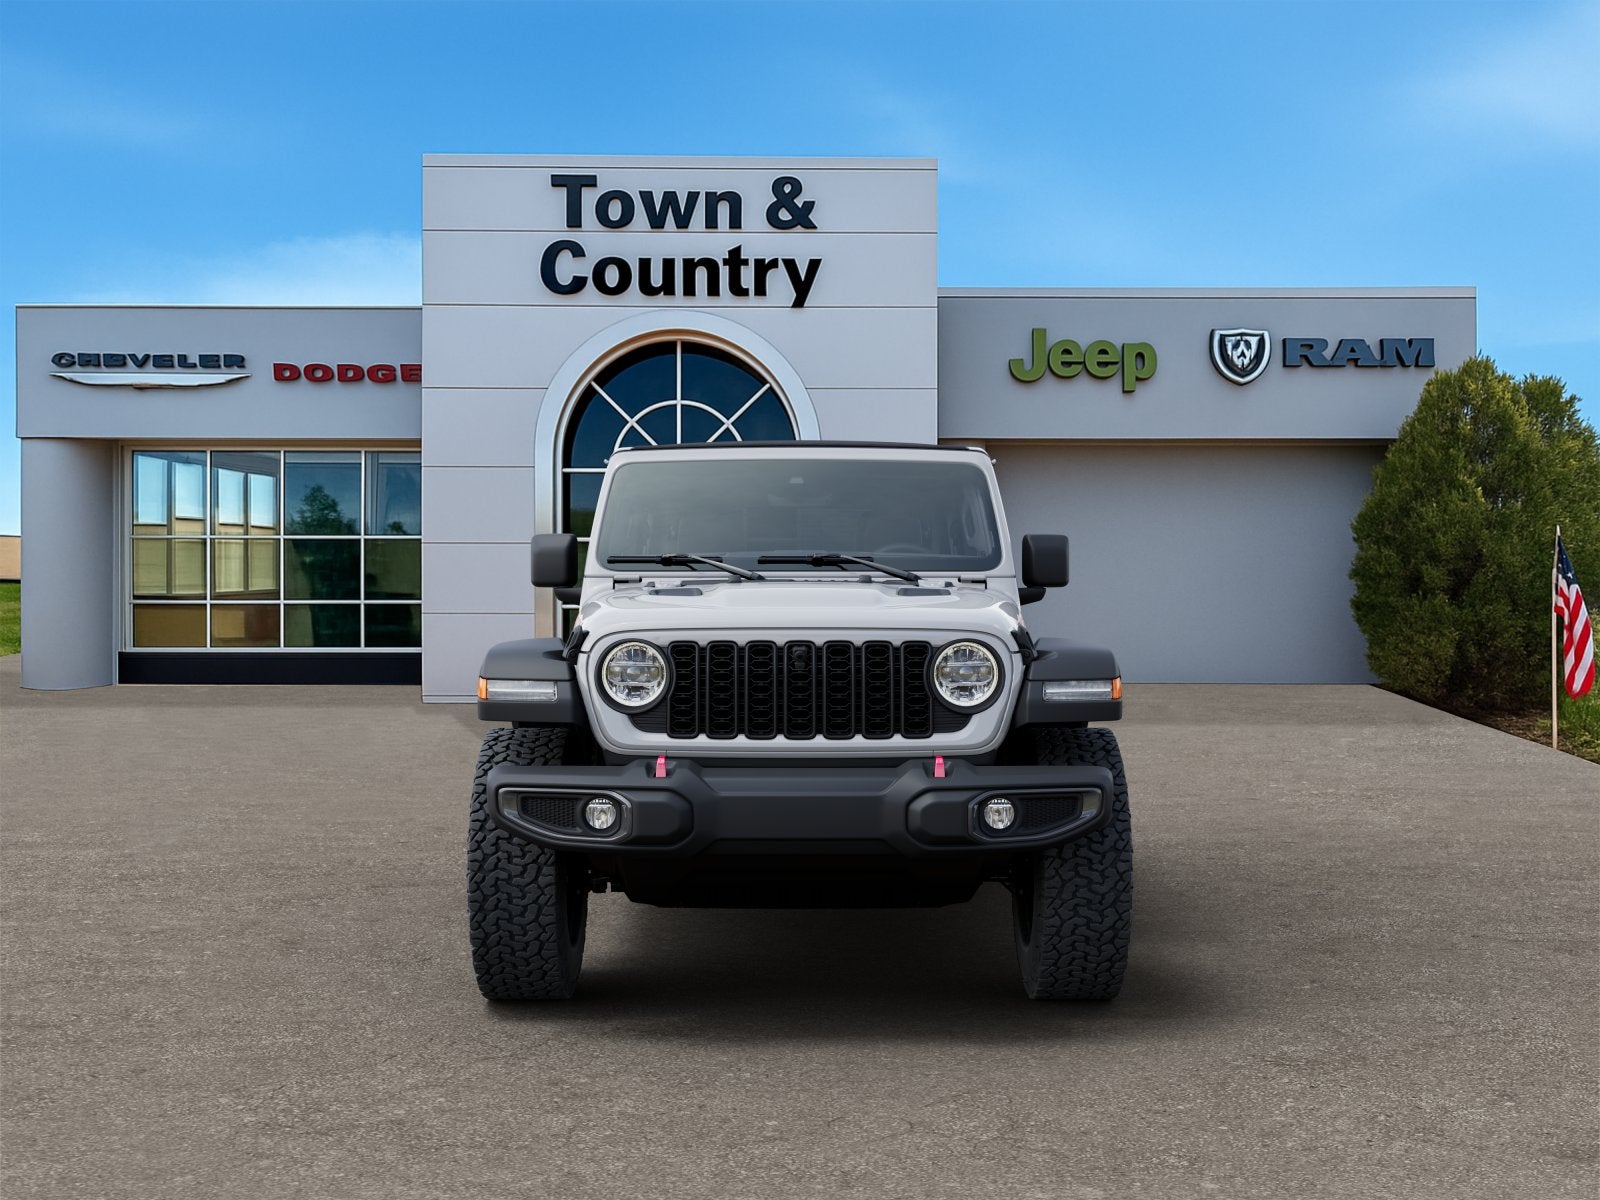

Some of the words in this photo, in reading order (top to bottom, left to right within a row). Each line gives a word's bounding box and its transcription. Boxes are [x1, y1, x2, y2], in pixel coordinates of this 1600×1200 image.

[550, 174, 743, 230] Town
[765, 175, 818, 230] &
[540, 239, 823, 308] Country
[272, 362, 422, 383] DODGE
[1008, 328, 1158, 393] Jeep
[1282, 338, 1436, 368] RAM
